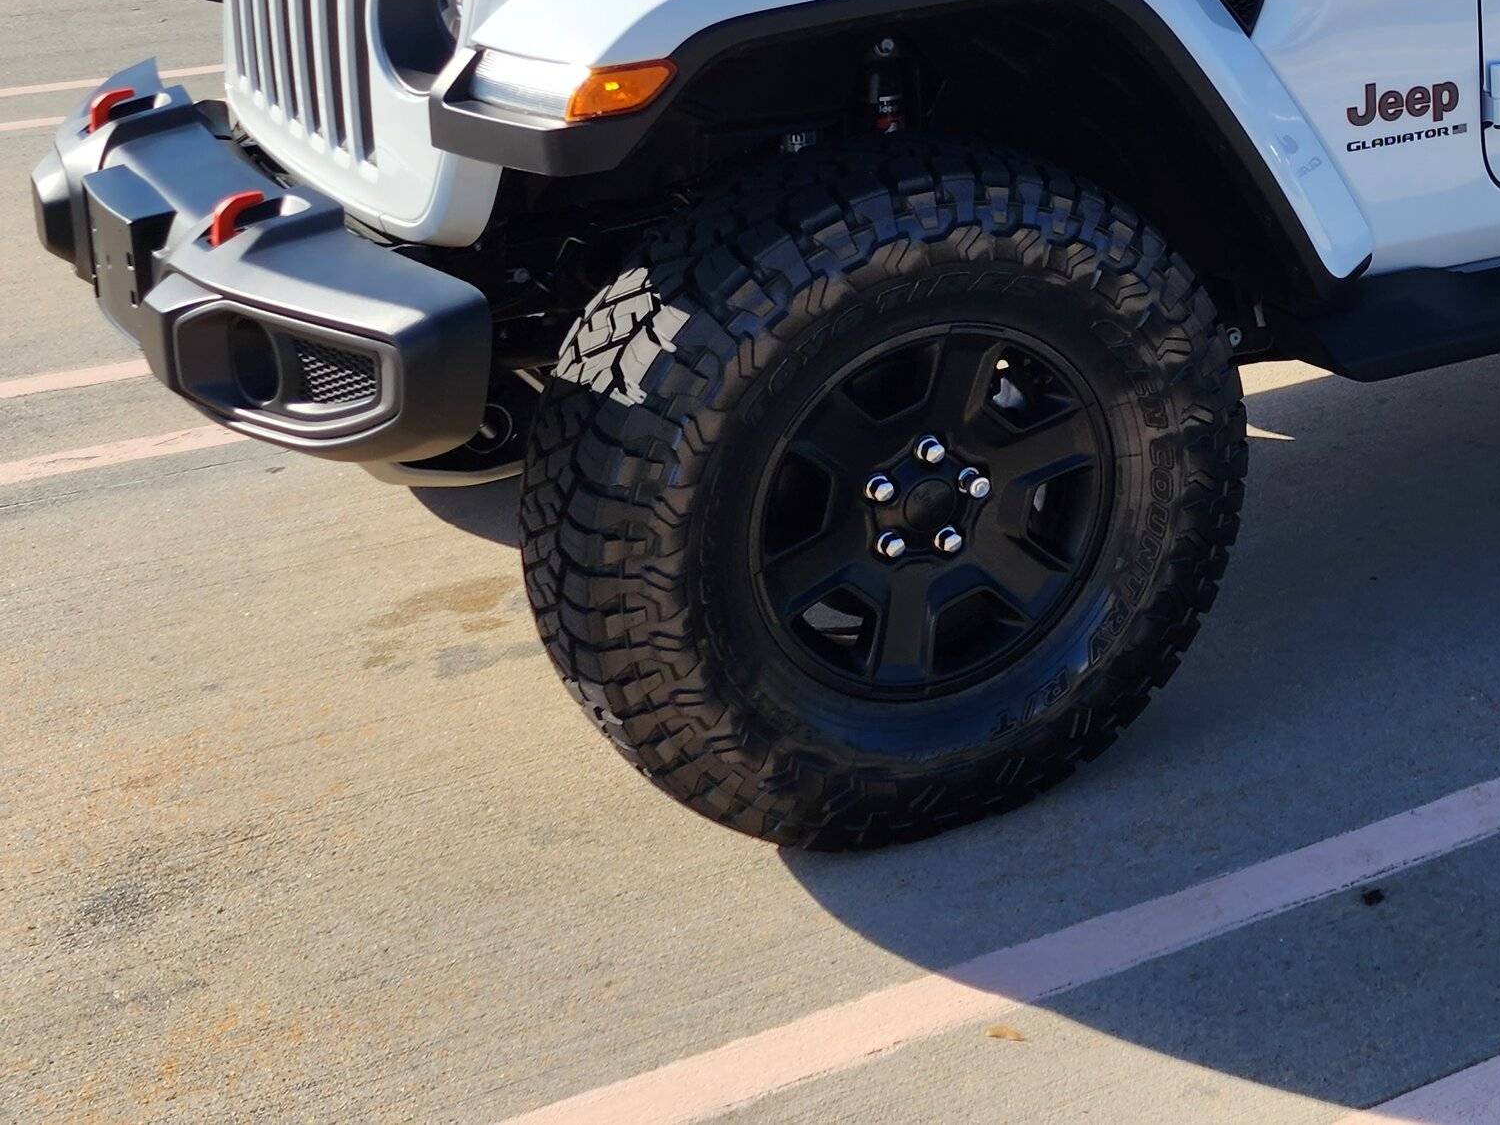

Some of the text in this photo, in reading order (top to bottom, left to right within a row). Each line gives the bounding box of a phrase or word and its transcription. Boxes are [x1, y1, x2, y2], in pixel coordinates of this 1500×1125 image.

[1346, 81, 1460, 127] Jeep
[1346, 127, 1450, 152] GLADIATOR
[1088, 437, 1176, 669] COUNTRY
